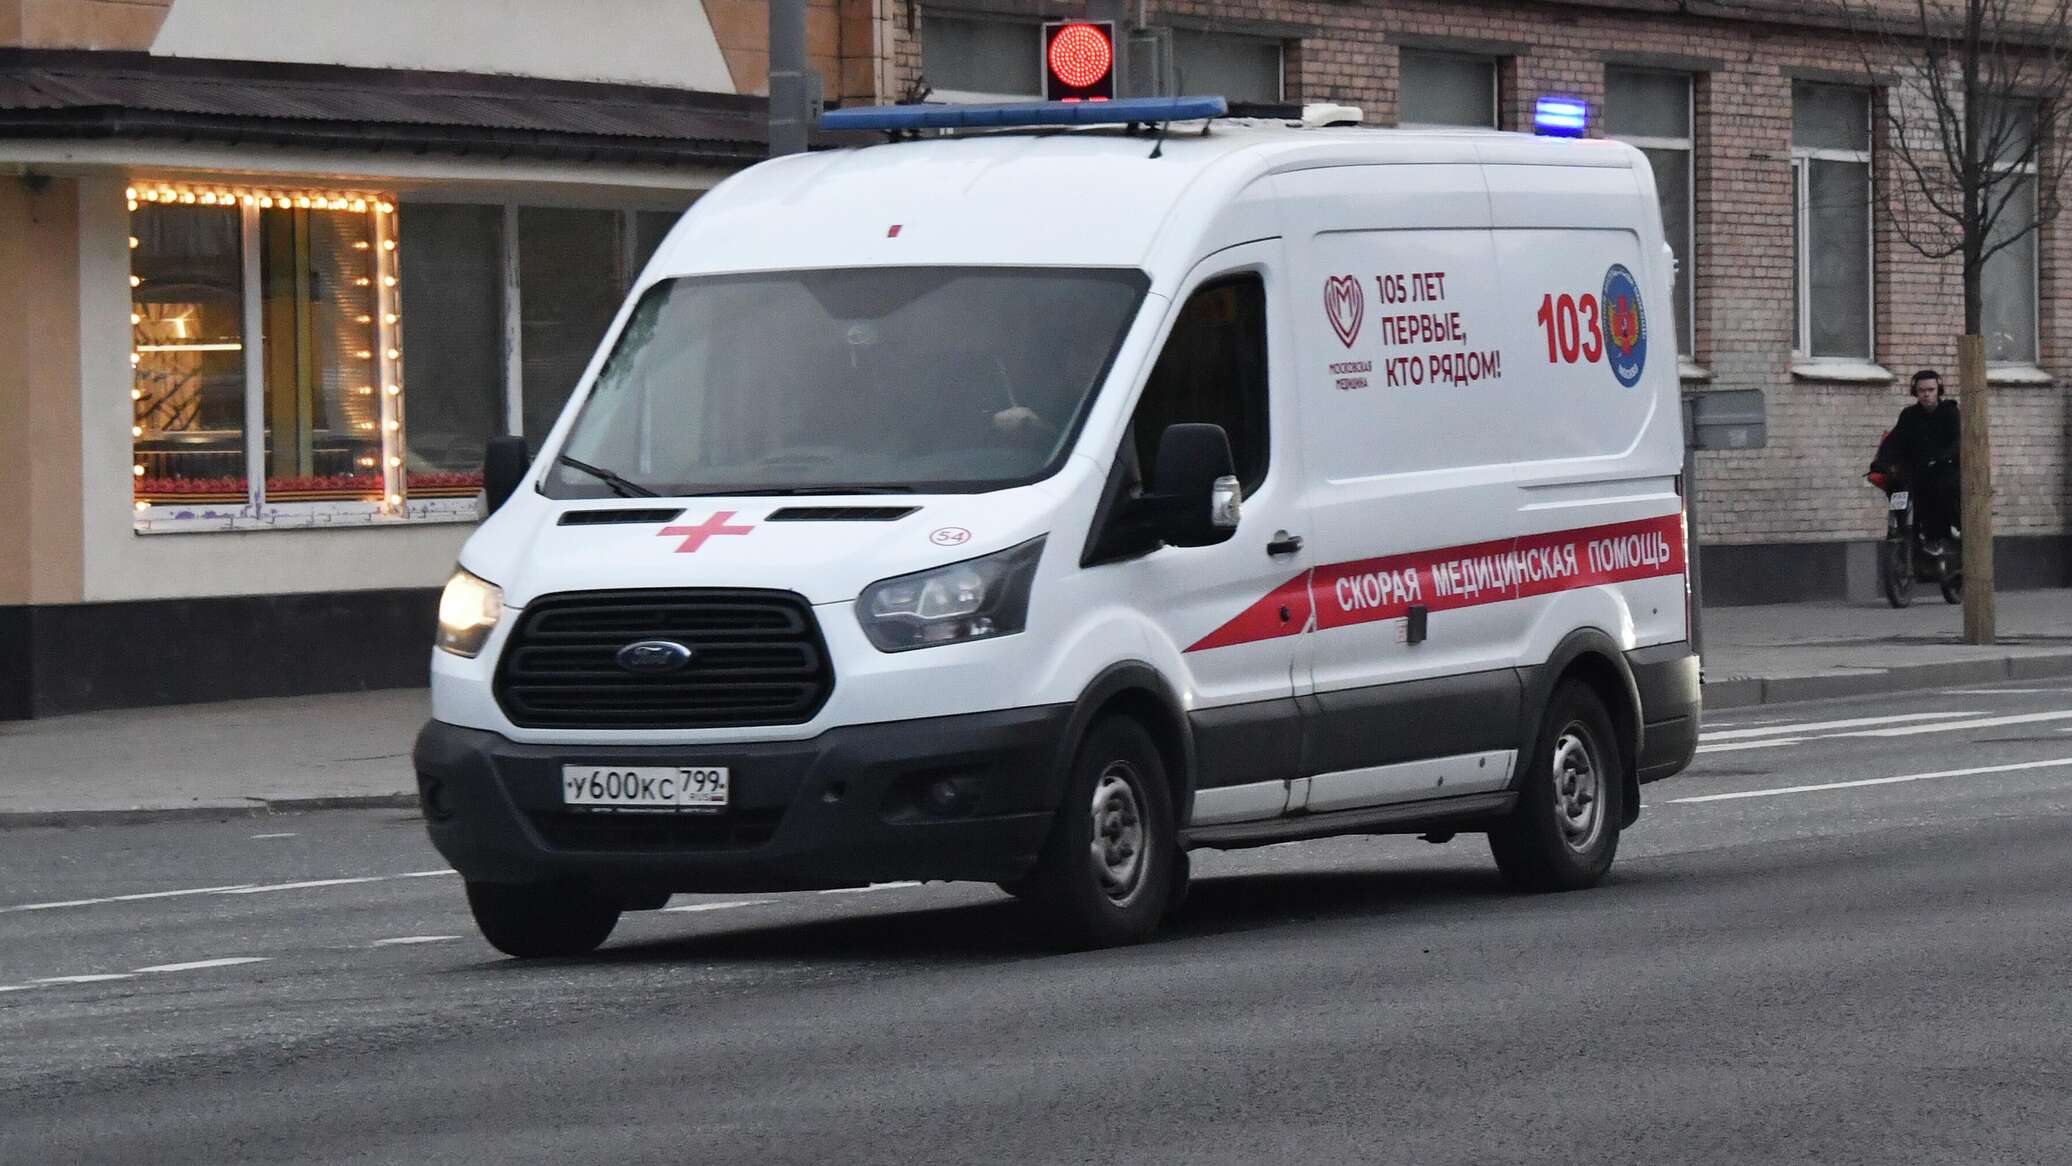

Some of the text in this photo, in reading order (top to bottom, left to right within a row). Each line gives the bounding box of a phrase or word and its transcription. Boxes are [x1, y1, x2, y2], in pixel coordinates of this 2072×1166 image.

[1376, 272, 1445, 304] 105 ЛЕТ
[1382, 312, 1467, 346] ПЕРВЫЕ,
[1537, 293, 1602, 364] 103
[1385, 350, 1502, 387] КТО РЯДОМ!
[935, 531, 965, 542] 54
[1335, 531, 1670, 611] СКОРАЯ МЕДИЦИНСКАЯ ПОМОЩЬ
[680, 770, 720, 792] 799
